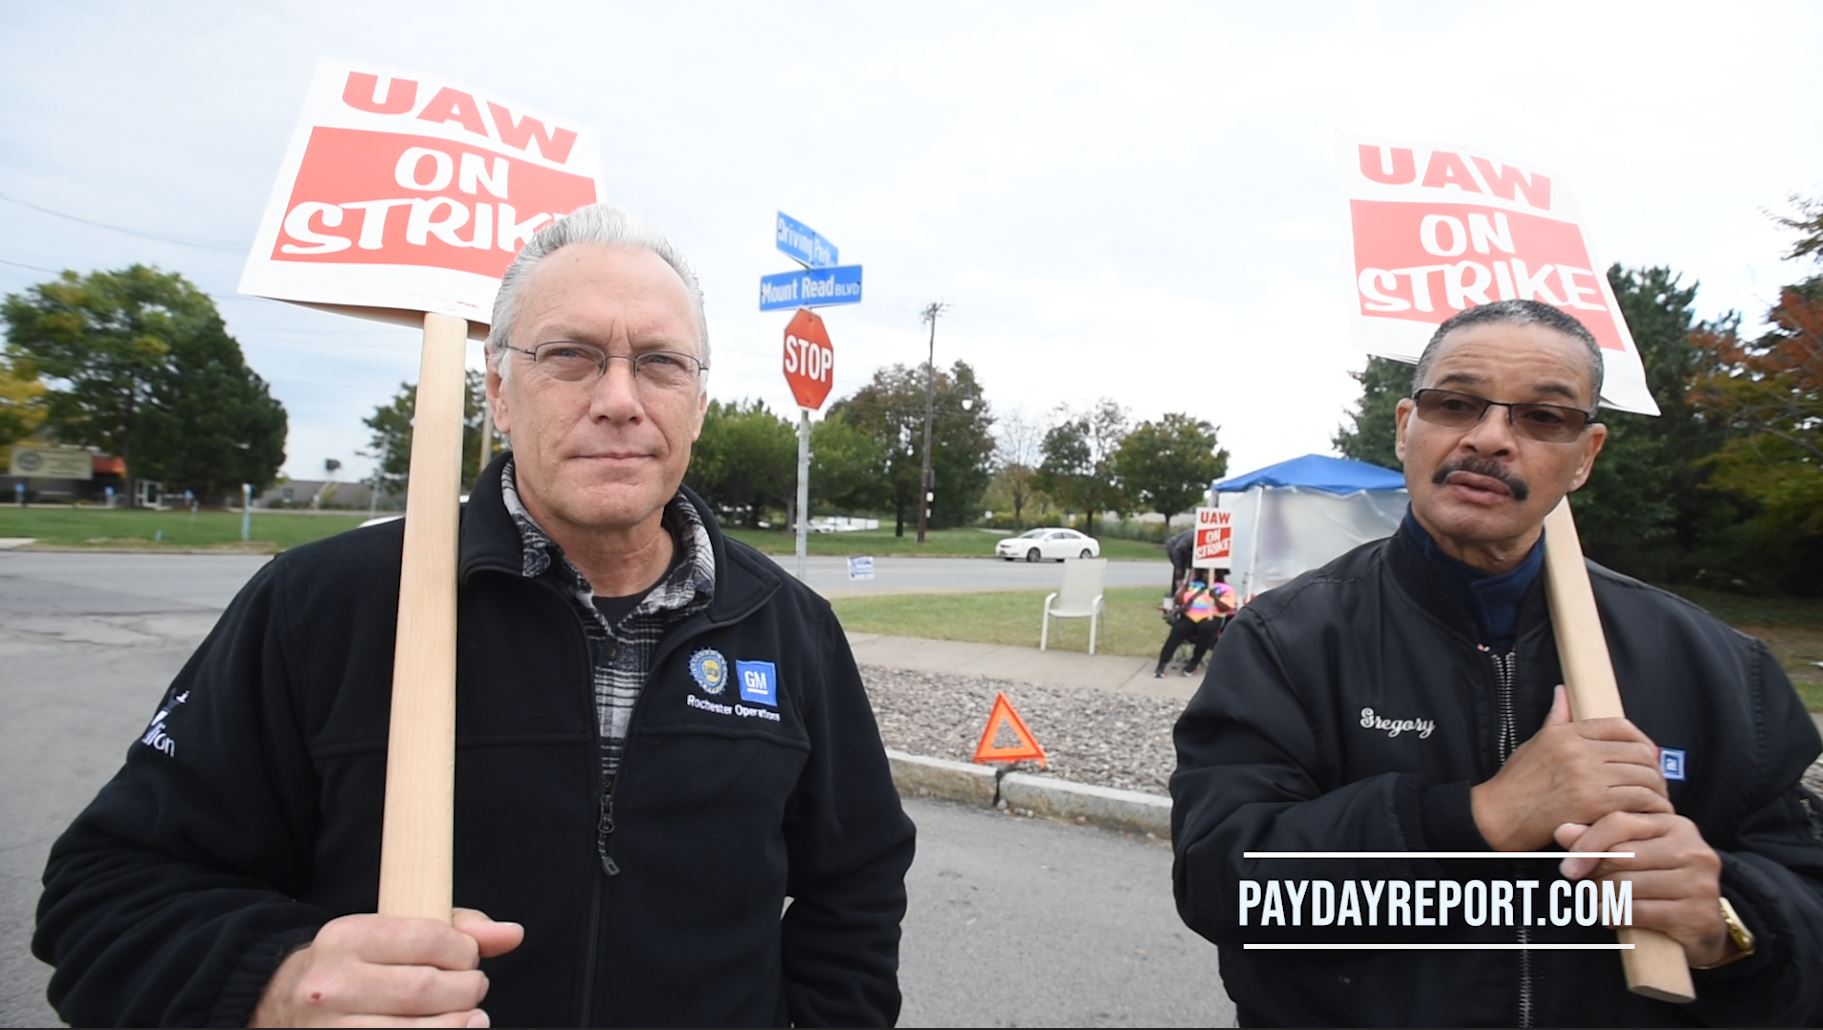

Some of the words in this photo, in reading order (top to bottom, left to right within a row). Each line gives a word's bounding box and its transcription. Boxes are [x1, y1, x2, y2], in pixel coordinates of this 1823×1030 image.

[342, 71, 578, 165] UAW
[394, 146, 510, 199] ON
[1358, 144, 1551, 212] UAW
[281, 196, 572, 255] STRIK
[1420, 212, 1516, 257] ON
[761, 281, 798, 304] Mount
[801, 276, 834, 299] Read
[835, 284, 860, 297] BLVD
[1358, 258, 1608, 313] STRIKE
[785, 335, 833, 383] STOP
[1201, 512, 1230, 524] UAW
[1205, 529, 1221, 543] ON
[744, 671, 768, 690] GM
[687, 695, 733, 714] Rochester
[735, 704, 780, 722] Operations
[1360, 707, 1436, 739] Gregory
